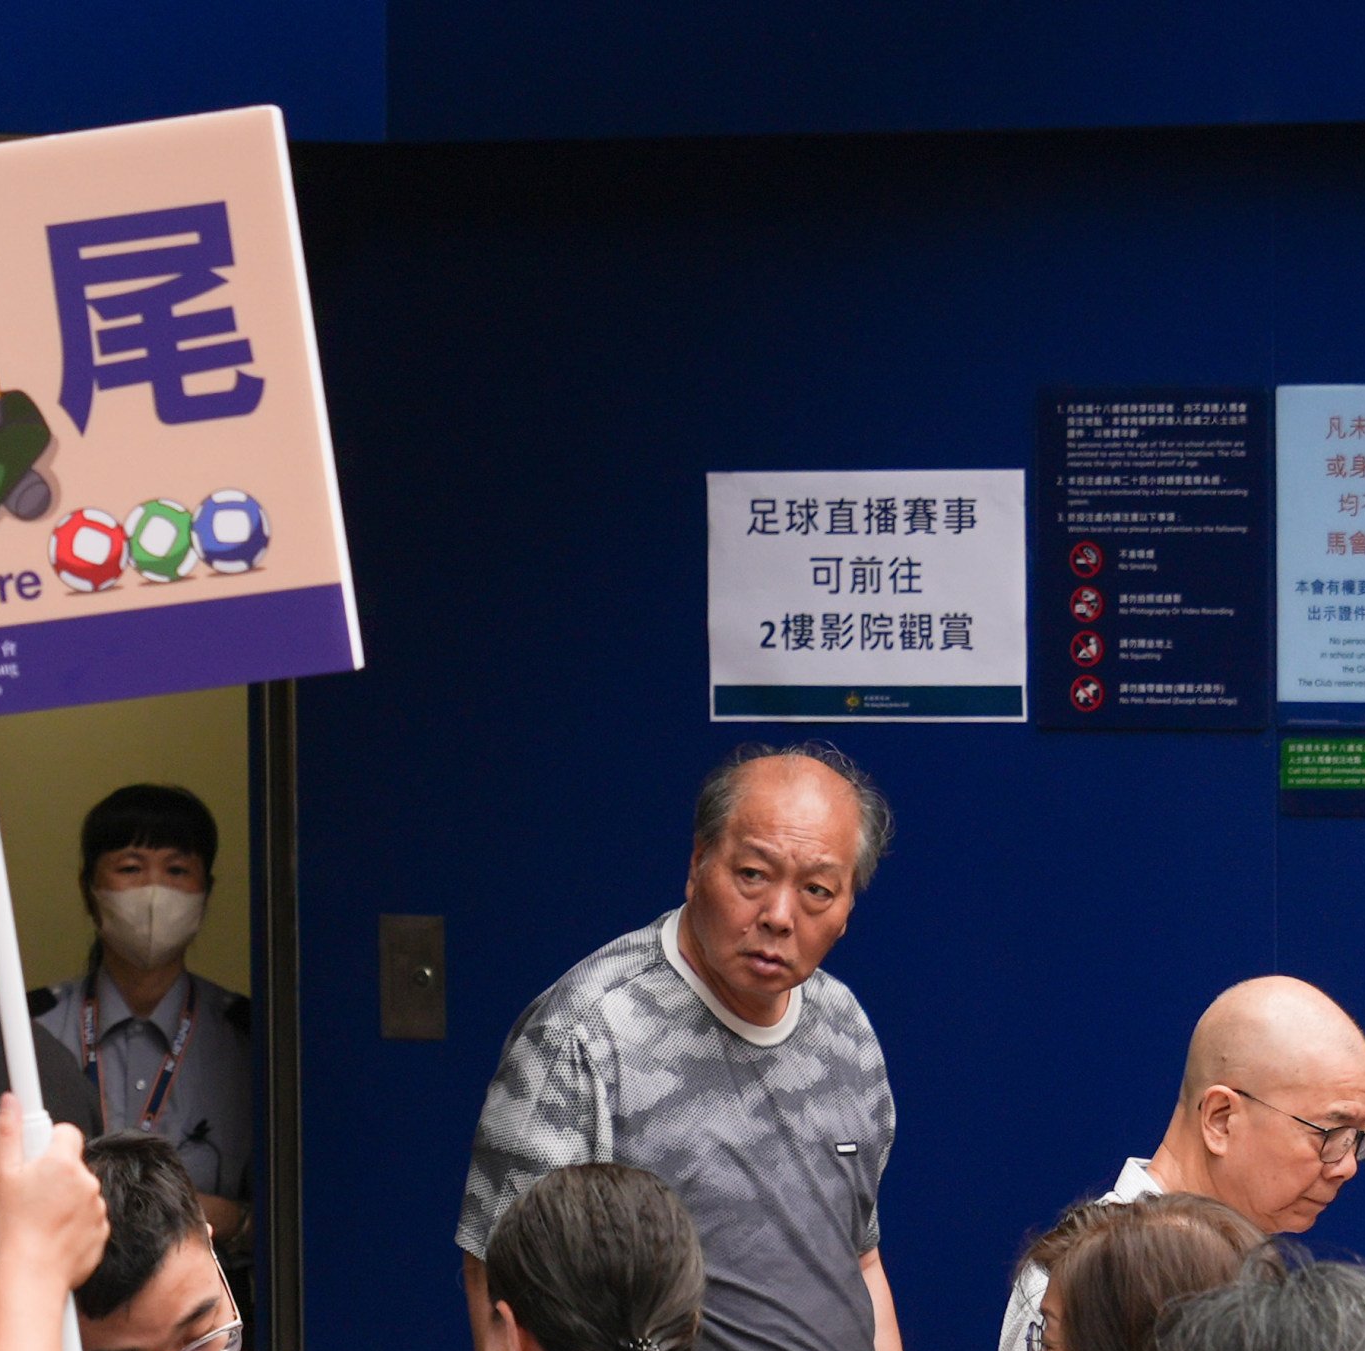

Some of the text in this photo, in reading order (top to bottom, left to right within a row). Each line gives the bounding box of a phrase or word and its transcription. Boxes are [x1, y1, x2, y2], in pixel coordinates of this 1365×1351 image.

[45, 201, 265, 437] 尾
[747, 498, 977, 535] 足球直播賽事
[810, 557, 922, 594] 可前往
[760, 613, 973, 651] 2樓影院觀賞
